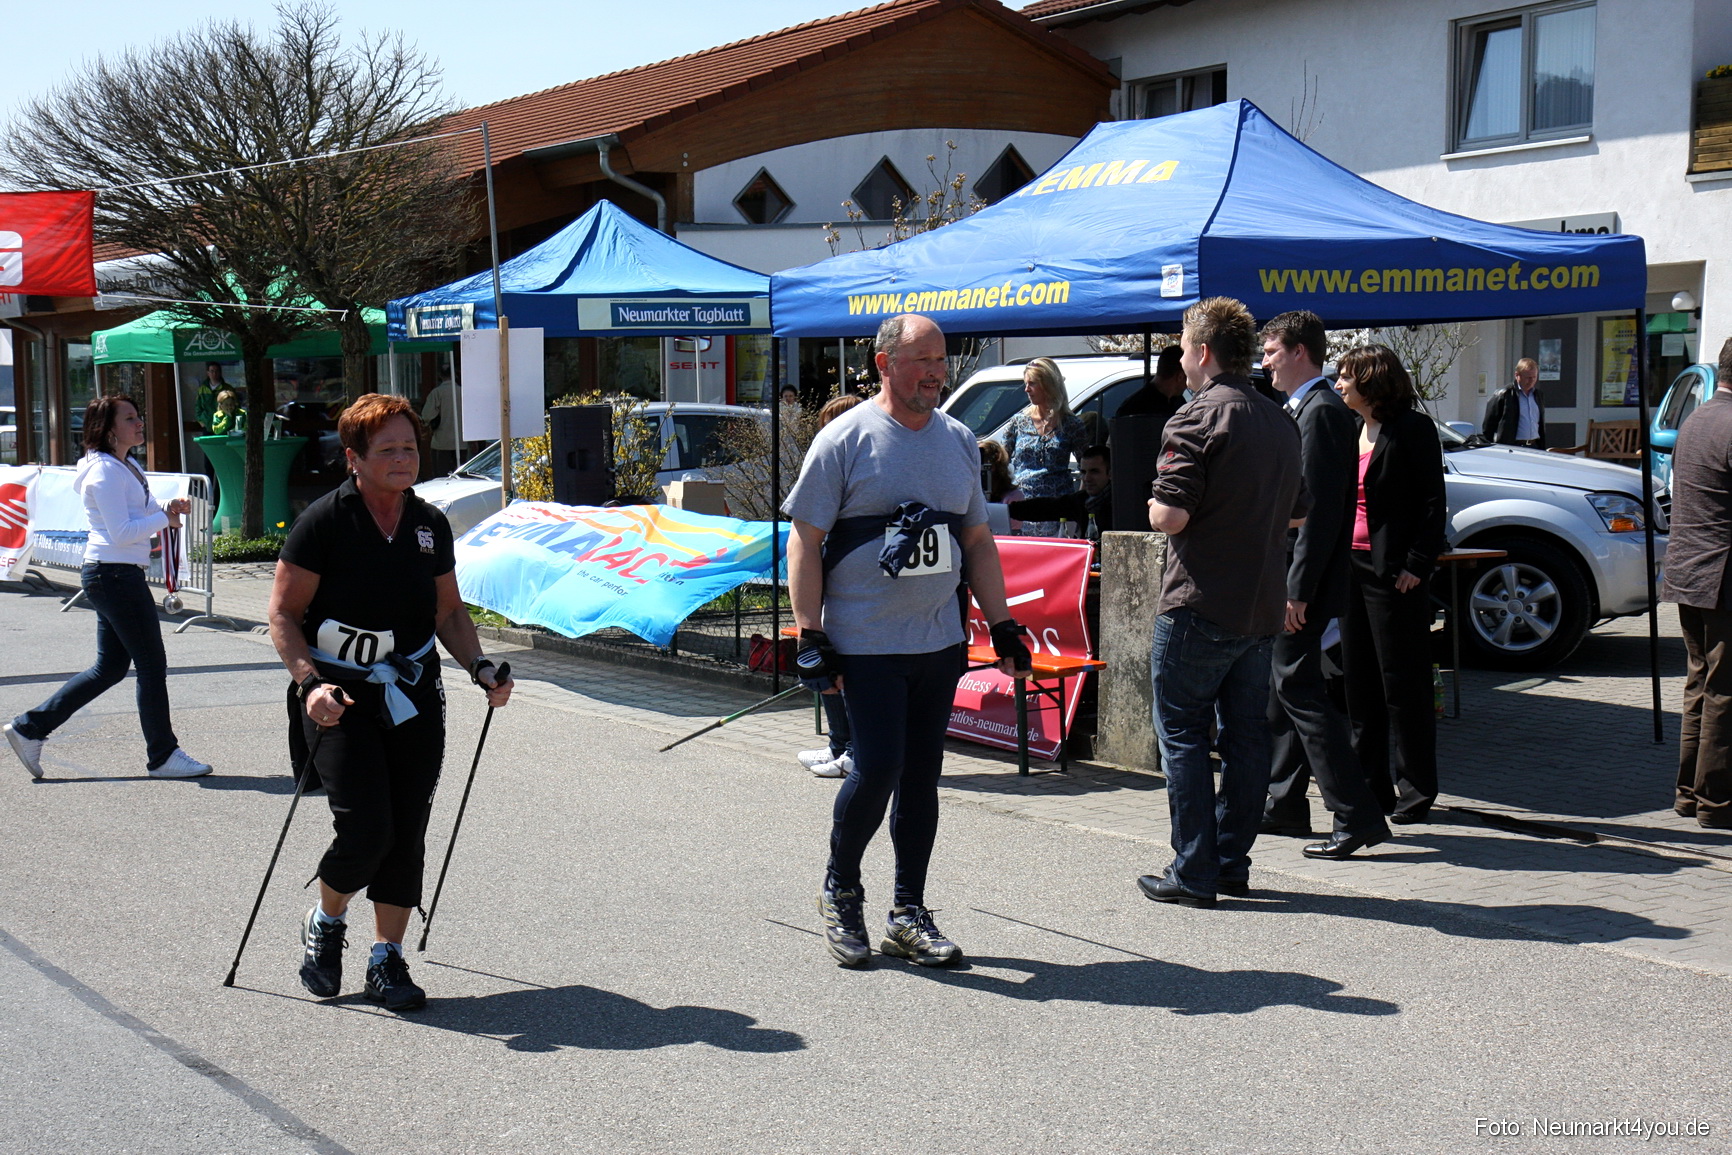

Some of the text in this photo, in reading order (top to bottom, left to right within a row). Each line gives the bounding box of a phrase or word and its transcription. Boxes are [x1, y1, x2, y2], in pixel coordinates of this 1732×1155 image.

[1031, 159, 1180, 196] EMMA
[1258, 261, 1600, 293] www.emmanet.com
[847, 279, 1070, 315] www.emmanet.com
[618, 306, 745, 324] Neumarkter Tagblatt
[185, 330, 236, 351] AOK
[669, 361, 720, 370] SEAT
[54, 539, 71, 553] Cross
[71, 541, 83, 555] the
[417, 530, 435, 549] 65
[337, 625, 378, 667] 70
